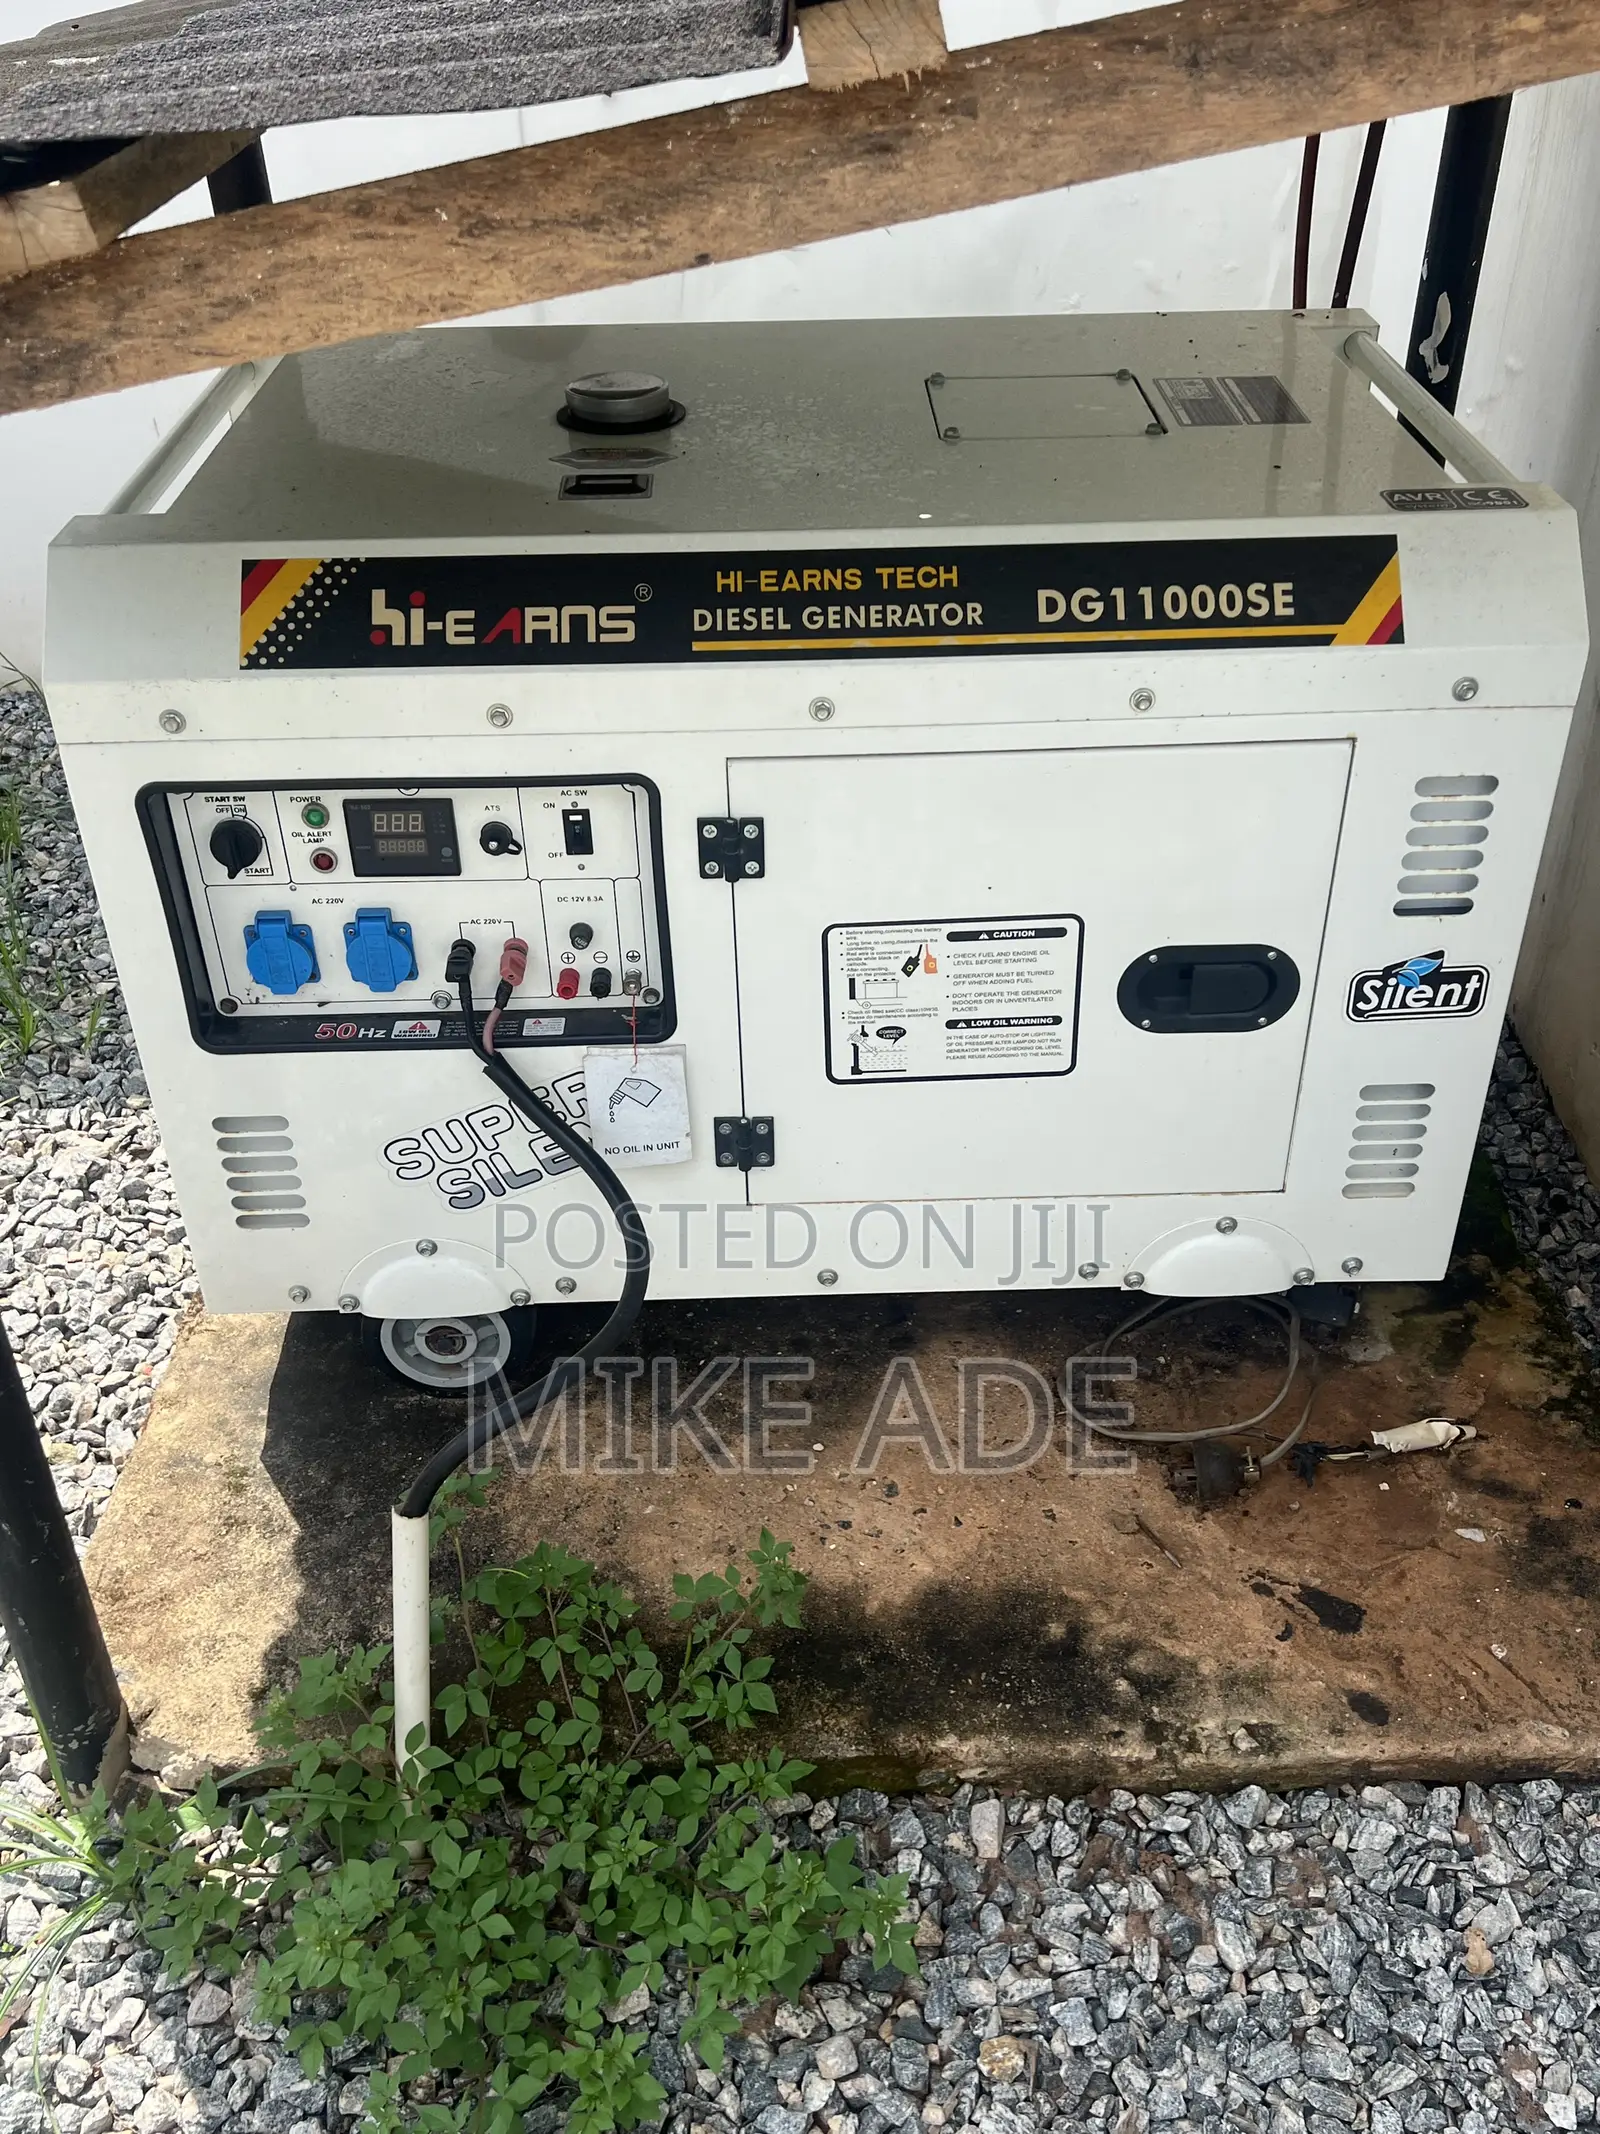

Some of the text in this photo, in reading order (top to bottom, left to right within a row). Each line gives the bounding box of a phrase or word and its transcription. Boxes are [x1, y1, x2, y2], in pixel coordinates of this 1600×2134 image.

[1393, 492, 1446, 502] AVR
[716, 565, 959, 593] HI-EARNS TECH
[1037, 582, 1294, 624] DG11000SE
[693, 602, 983, 633] DIESEL GENERATOR
[993, 930, 1036, 938] CAUTION
[1356, 975, 1481, 1011] Silent
[1010, 1017, 1053, 1025] WARNING
[604, 1141, 680, 1156] NO OIL IN UNIT
